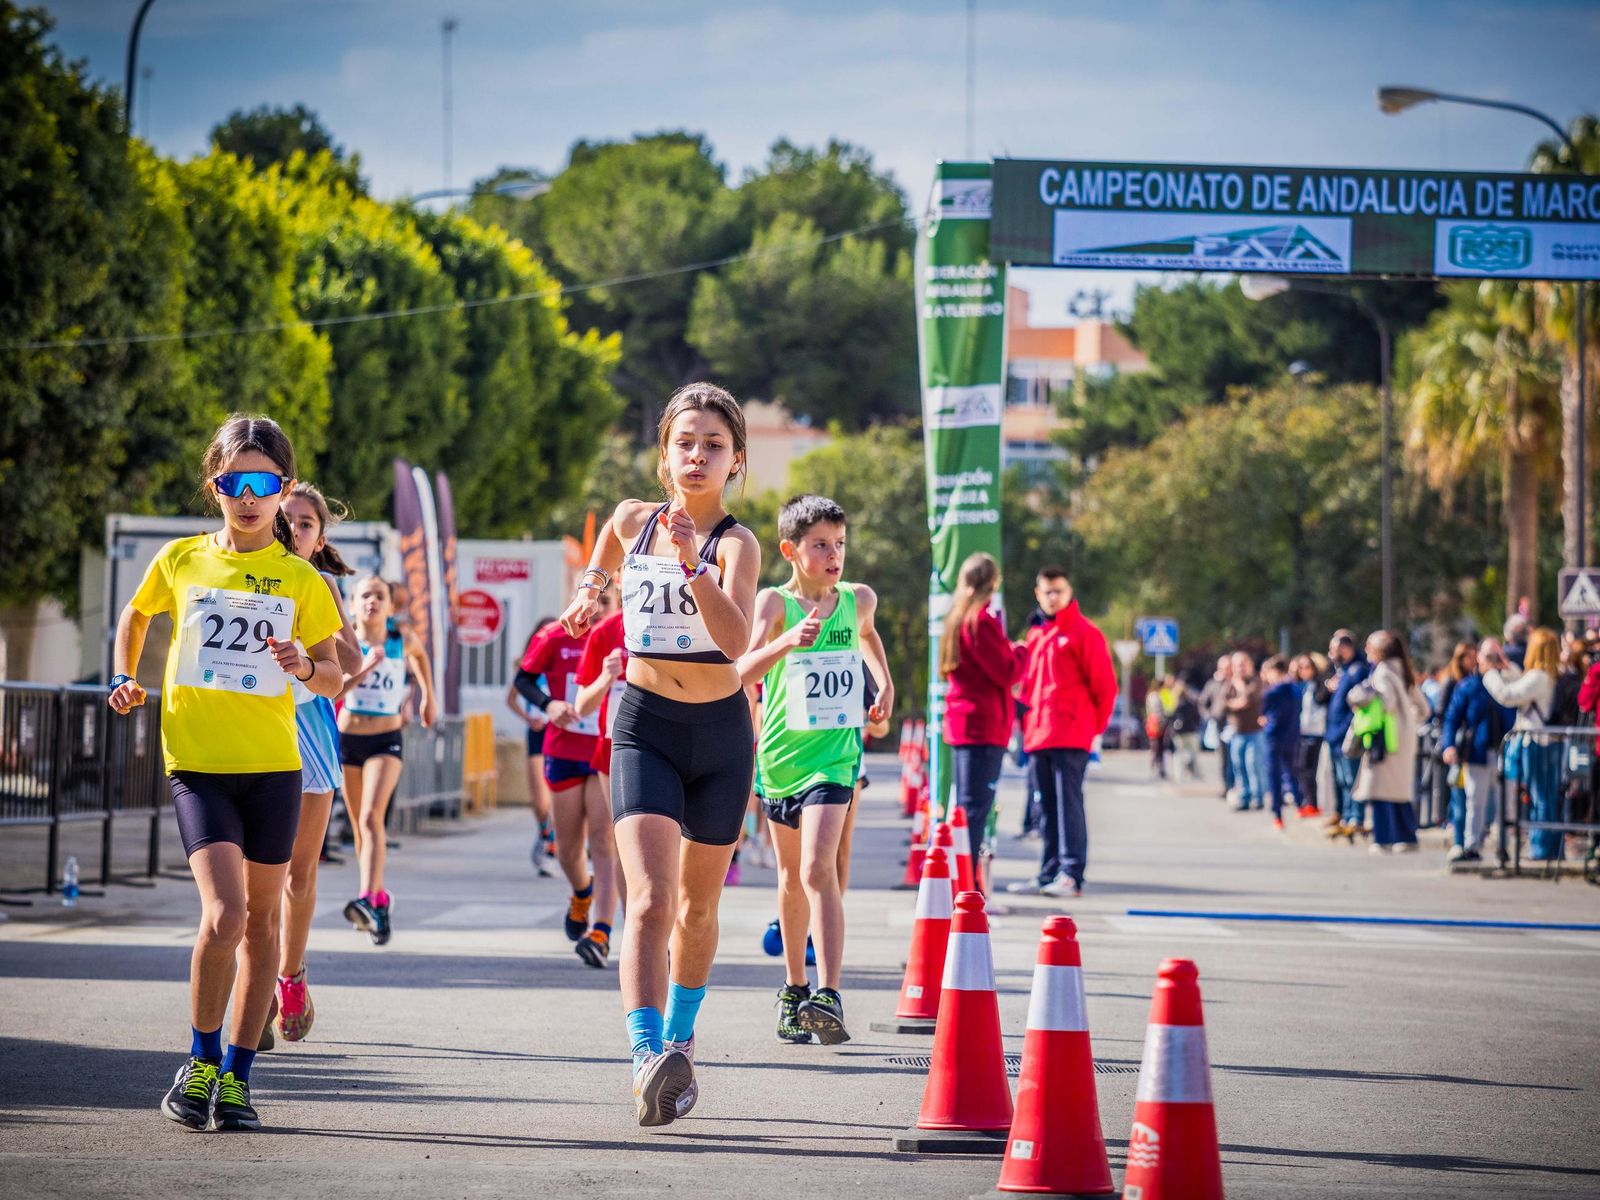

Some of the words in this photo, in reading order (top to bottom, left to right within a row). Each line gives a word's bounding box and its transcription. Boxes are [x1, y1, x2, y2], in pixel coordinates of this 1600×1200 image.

[1039, 168, 1245, 209] CAMPEONATO
[1252, 174, 1291, 211] DE
[1297, 175, 1467, 215] ANDALUCIA
[1475, 180, 1514, 217] DE
[638, 580, 699, 616] 218
[202, 614, 275, 654] 229
[806, 669, 854, 699] 209
